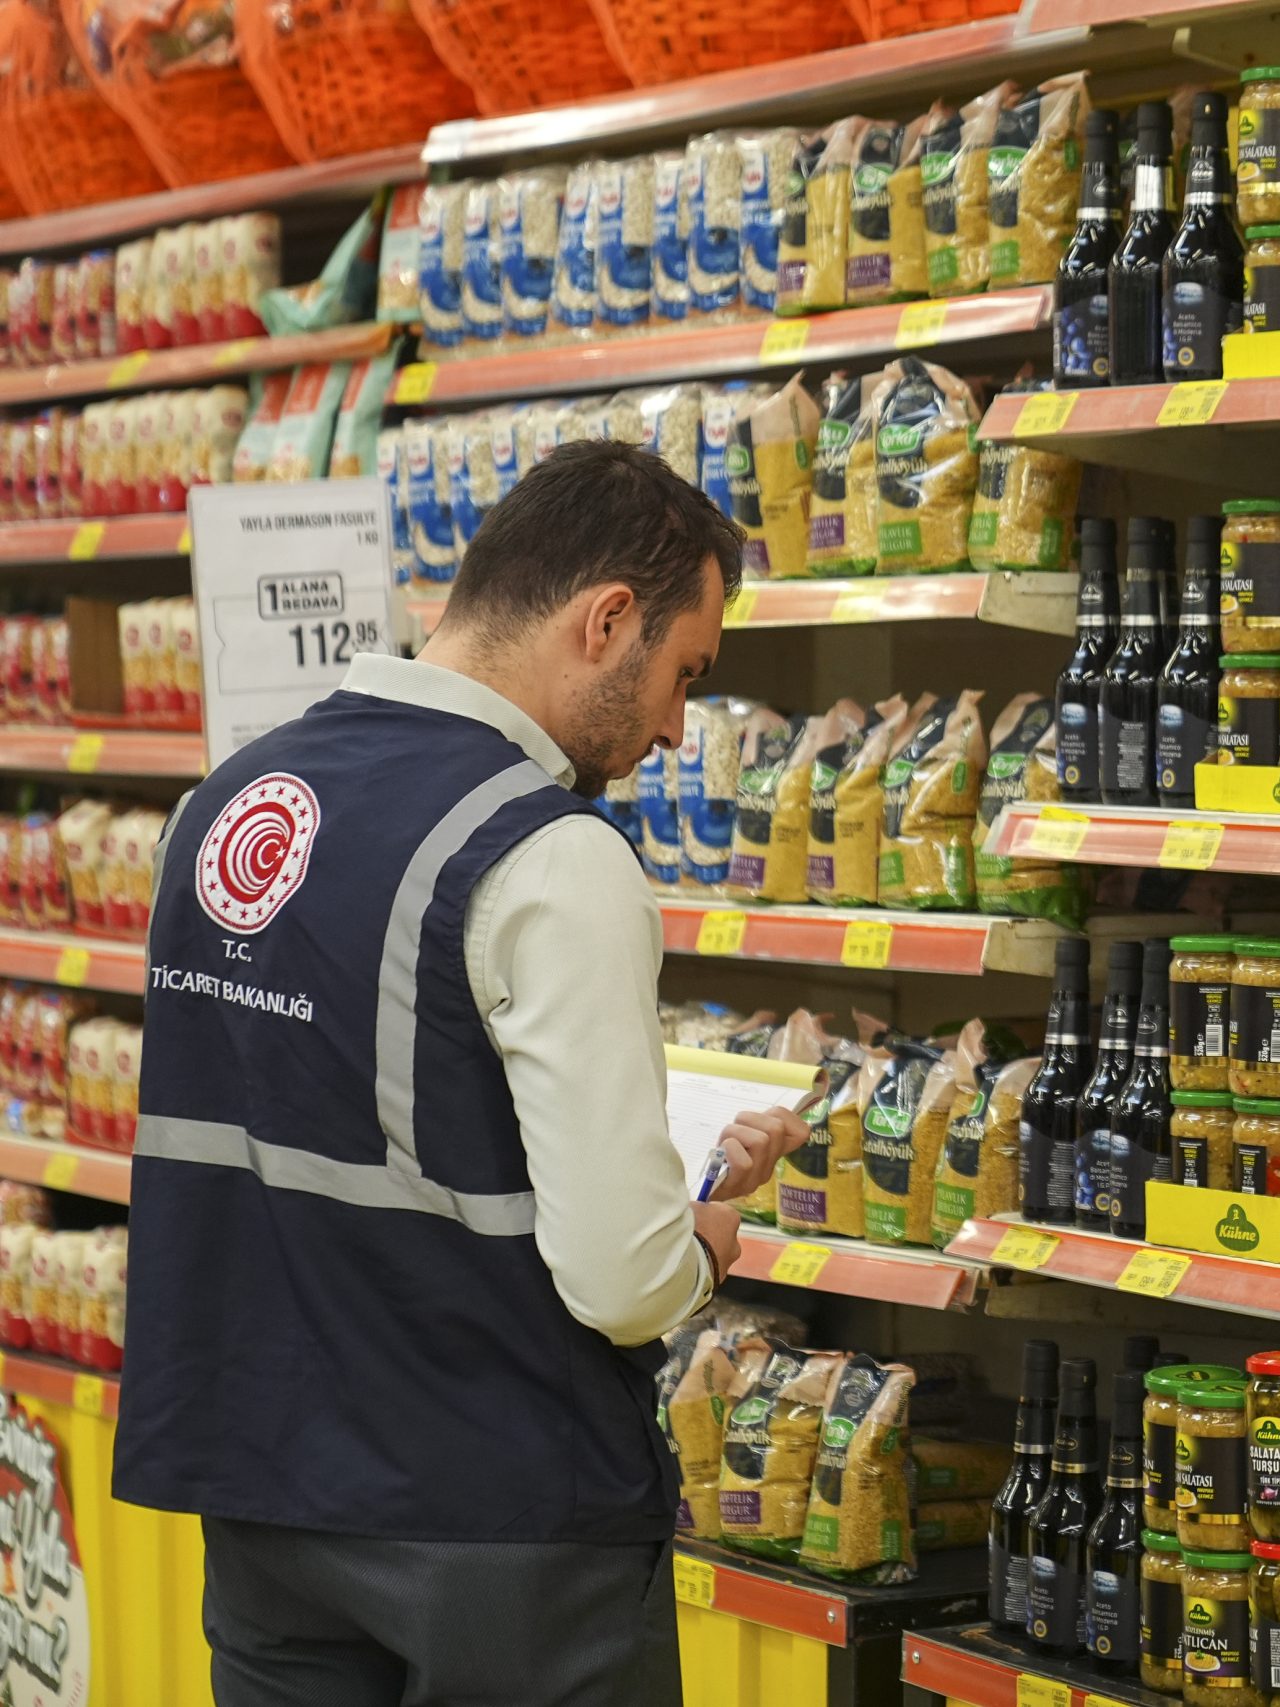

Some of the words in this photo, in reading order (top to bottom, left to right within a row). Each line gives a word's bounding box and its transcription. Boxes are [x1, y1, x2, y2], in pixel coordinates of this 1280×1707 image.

[240, 517, 272, 532] YAYLA
[275, 514, 332, 529] DERMASON
[334, 511, 376, 526] FASULYE
[364, 531, 378, 545] KG
[281, 580, 329, 594] ALANA
[264, 583, 278, 614] 1
[282, 596, 339, 610] BEDAVA
[222, 939, 252, 962] T.C.
[152, 964, 220, 998] TİCARET
[223, 981, 312, 1022] BAKANLIĞI
[1219, 1225, 1257, 1242] Kühne
